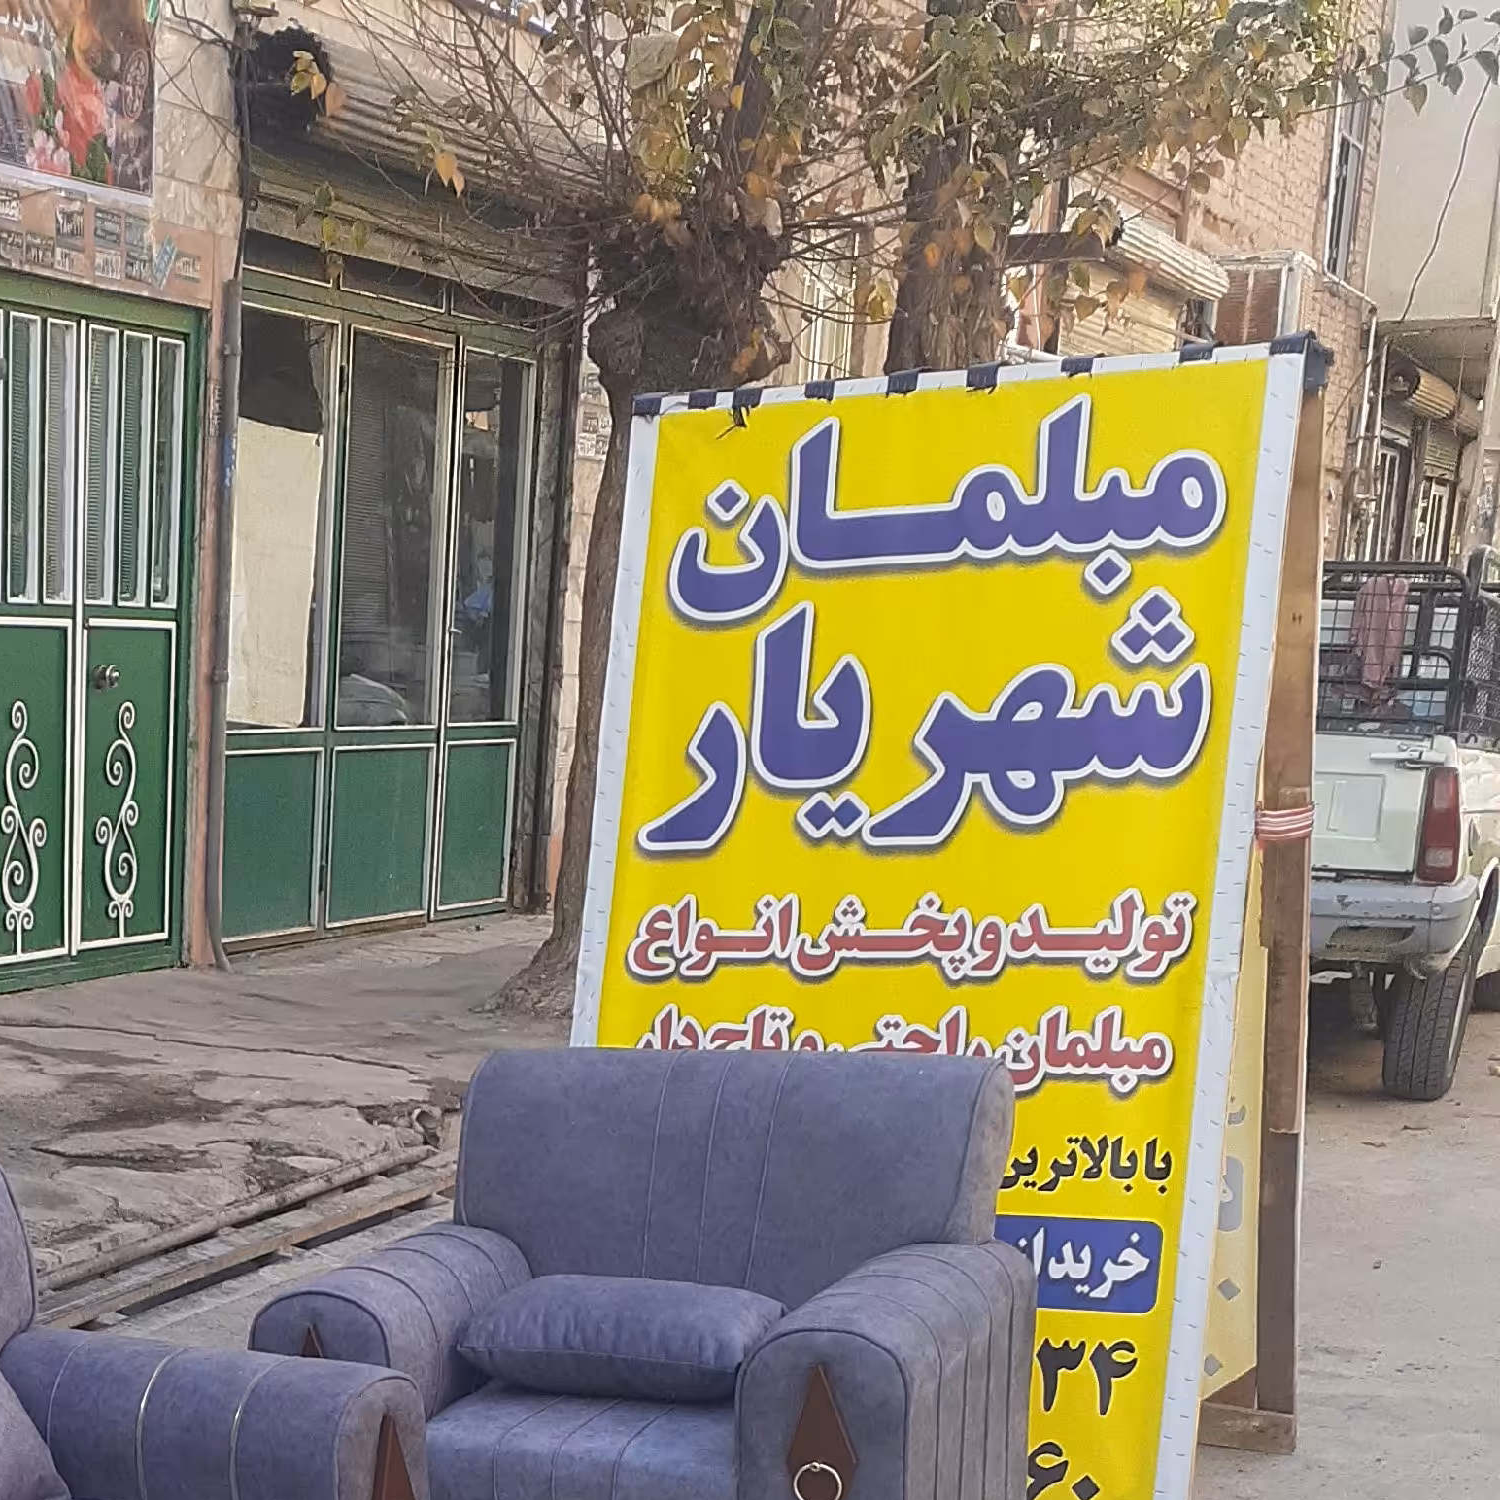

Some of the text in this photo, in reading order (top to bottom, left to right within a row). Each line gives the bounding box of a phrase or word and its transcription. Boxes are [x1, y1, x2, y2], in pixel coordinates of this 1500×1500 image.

[669, 394, 1227, 622] مبلمان
[636, 587, 1211, 851] شهریار
[627, 887, 1198, 979] تولید و پخش انواع
[995, 1005, 1174, 1093] مبلمان
[1144, 1136, 1173, 1195] با
[1048, 1231, 1151, 1299] خرید
